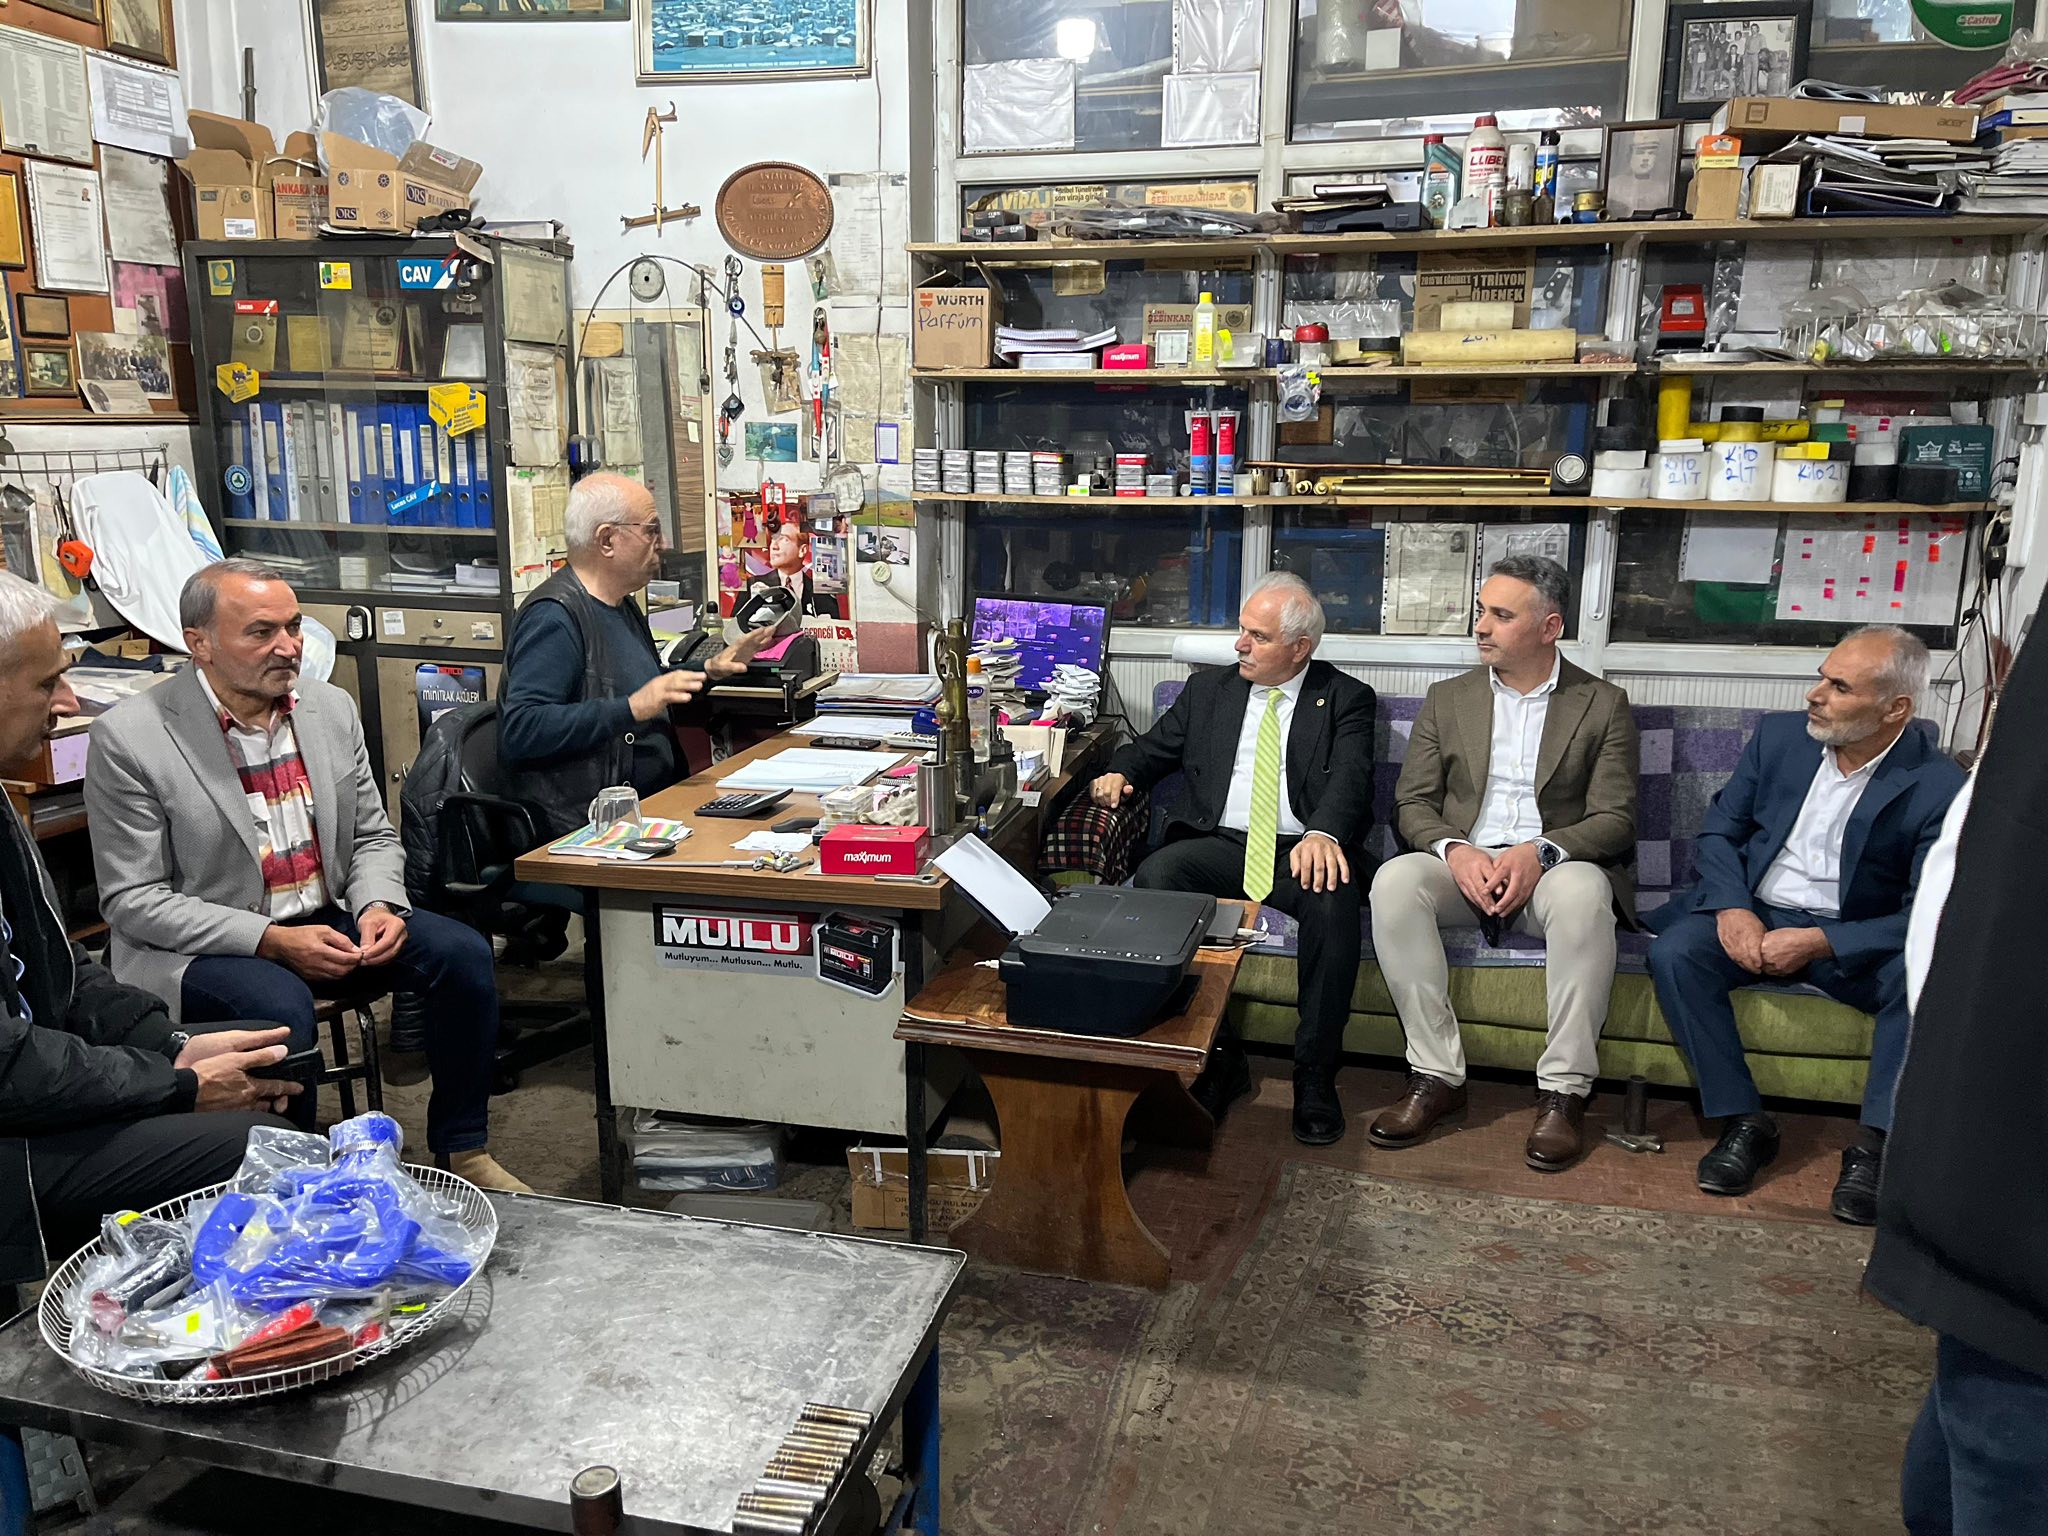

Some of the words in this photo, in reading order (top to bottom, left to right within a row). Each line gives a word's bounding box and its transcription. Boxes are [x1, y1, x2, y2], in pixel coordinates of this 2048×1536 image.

[1967, 16, 1998, 25] Castrol
[1937, 118, 1968, 128] acer
[277, 184, 311, 196] ANKARA
[405, 185, 426, 205] ORS
[336, 207, 357, 219] ORS
[402, 266, 432, 283] CAV
[1481, 272, 1525, 286] TRİLYON
[937, 295, 984, 306] WÜRTH
[1472, 287, 1524, 302] ÖDENEK
[918, 308, 983, 331] Parfüm
[1725, 442, 1758, 464] Kilo
[1797, 462, 1824, 484] Kilo
[843, 851, 892, 864] maximum
[662, 916, 800, 951] MUTLU
[665, 952, 718, 964] Mutluyum...
[721, 956, 771, 967] Mutlusun...
[774, 959, 803, 970] Mutlu.
